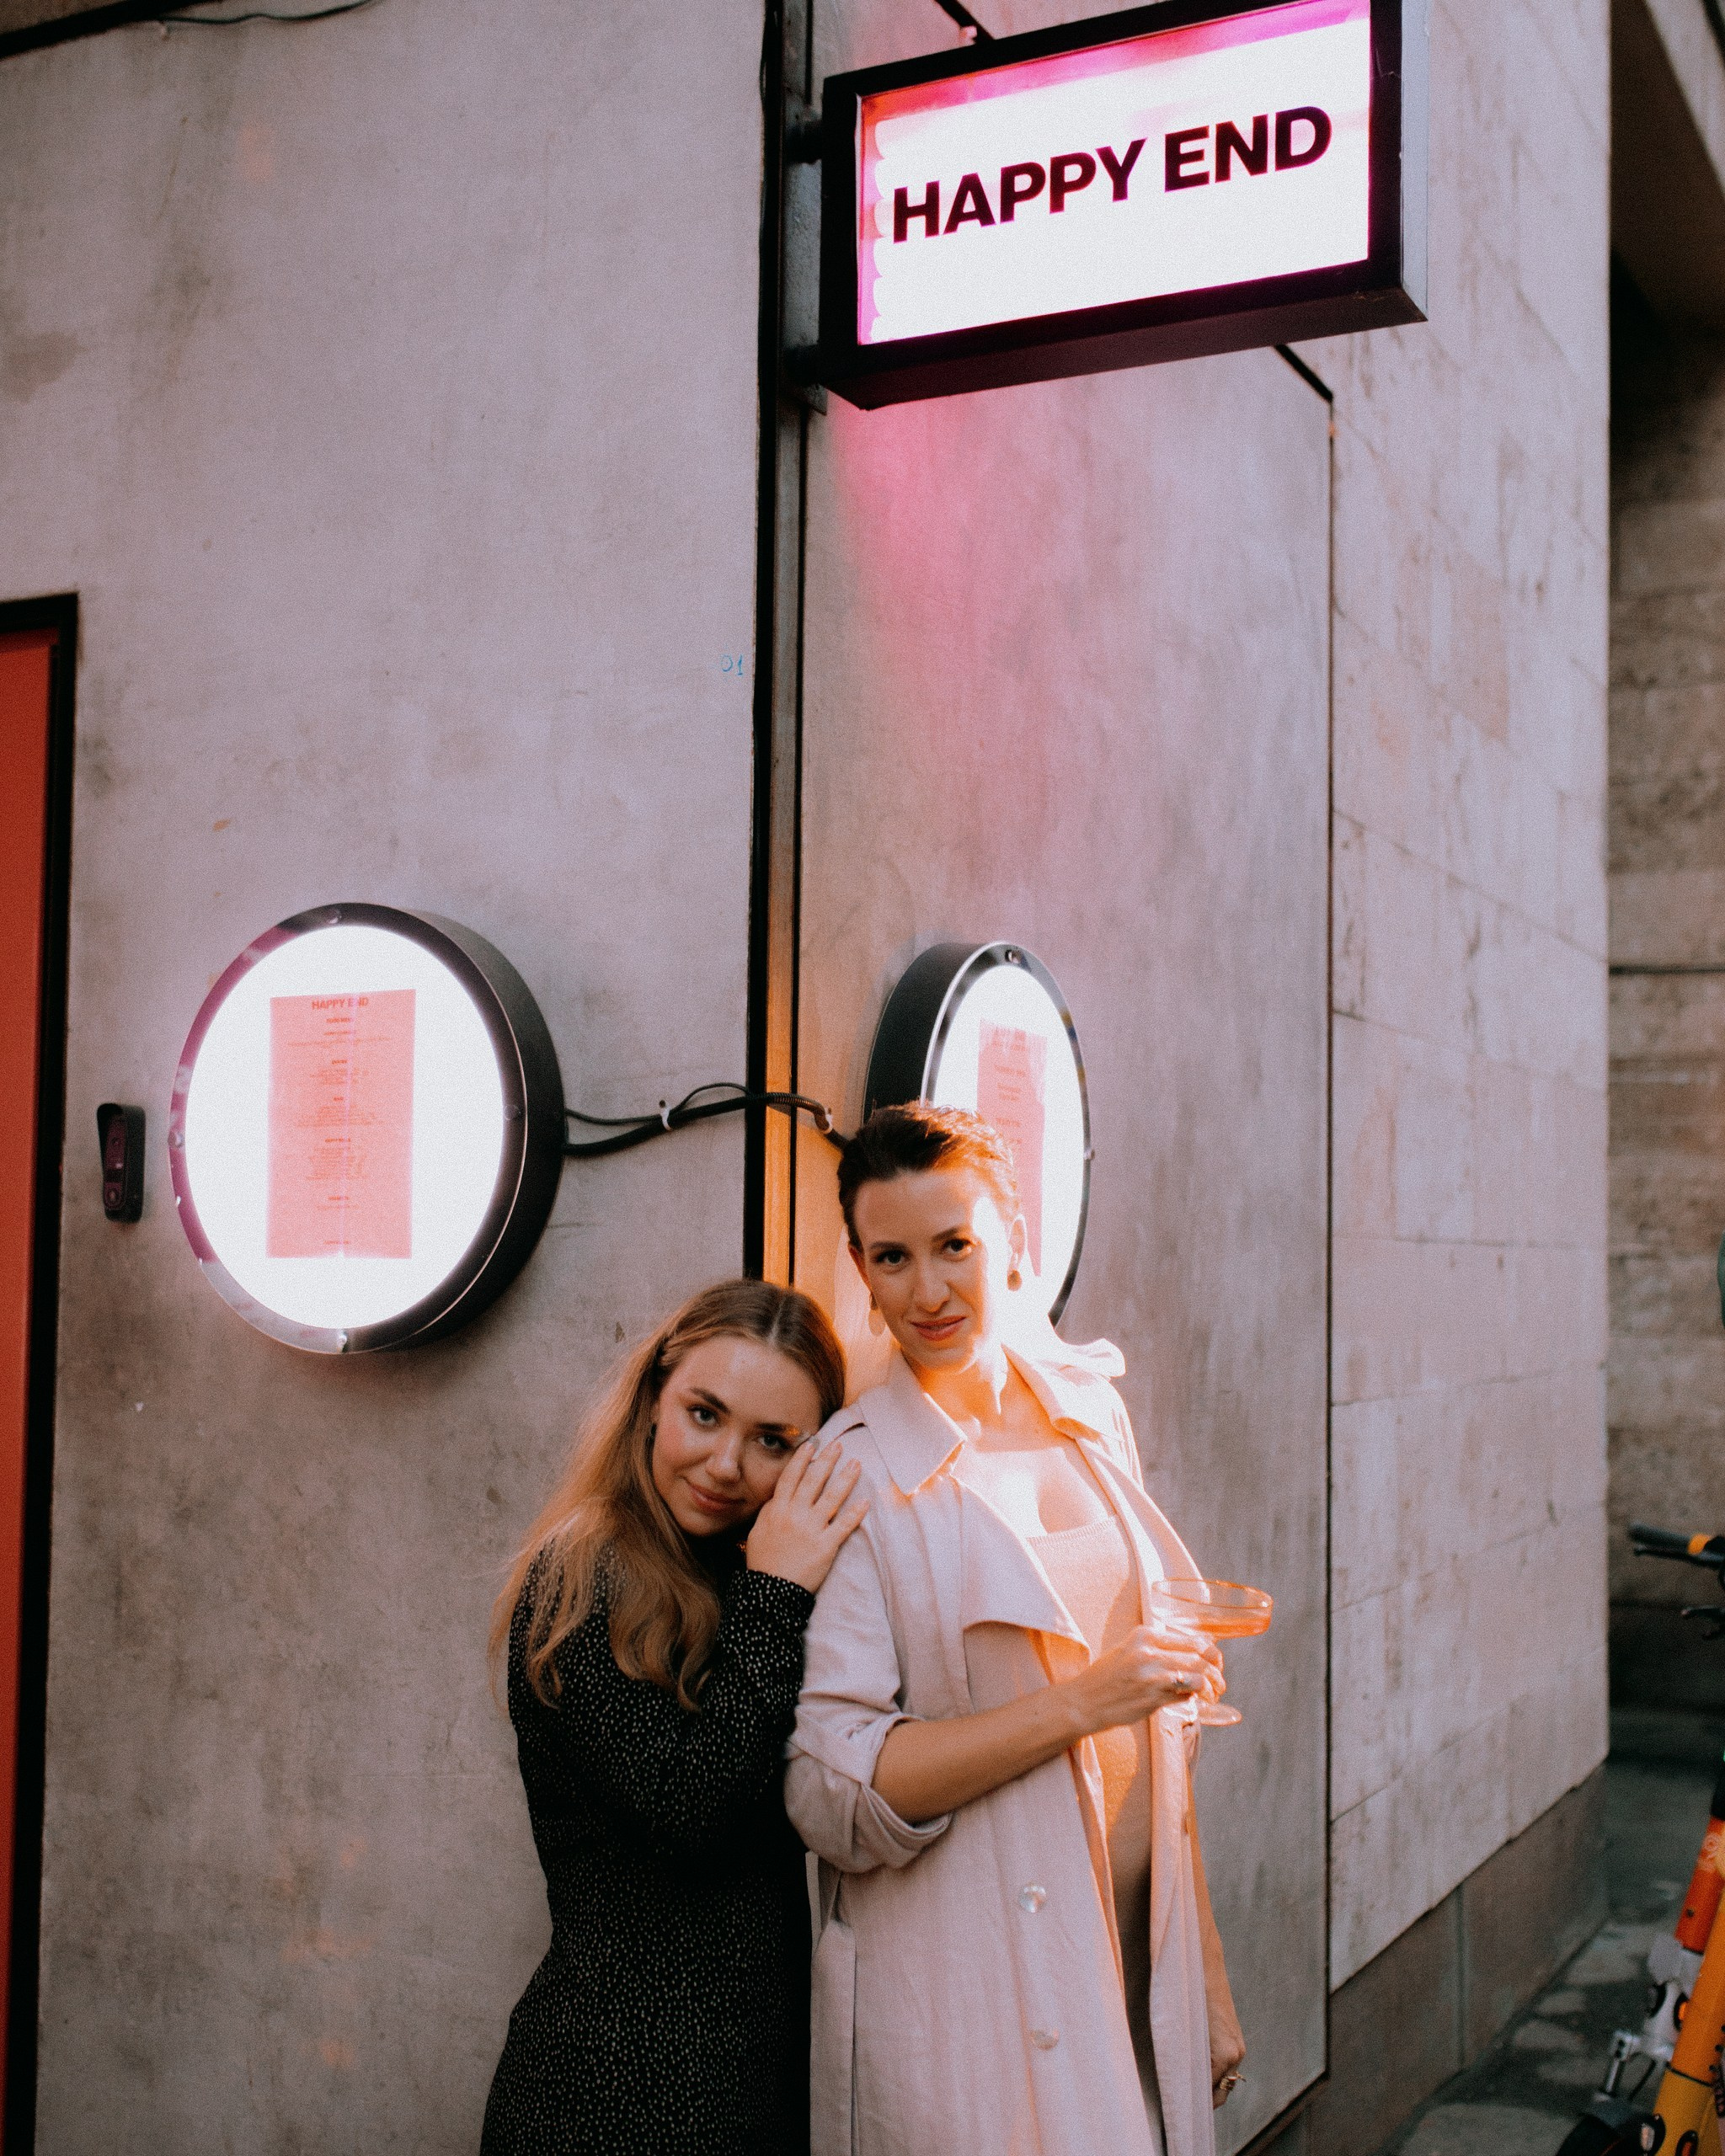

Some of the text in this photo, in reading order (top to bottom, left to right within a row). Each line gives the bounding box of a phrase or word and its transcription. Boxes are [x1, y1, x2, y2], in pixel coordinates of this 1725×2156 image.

[893, 105, 1332, 243] HAPPY END
[312, 998, 345, 1010] HAPPY
